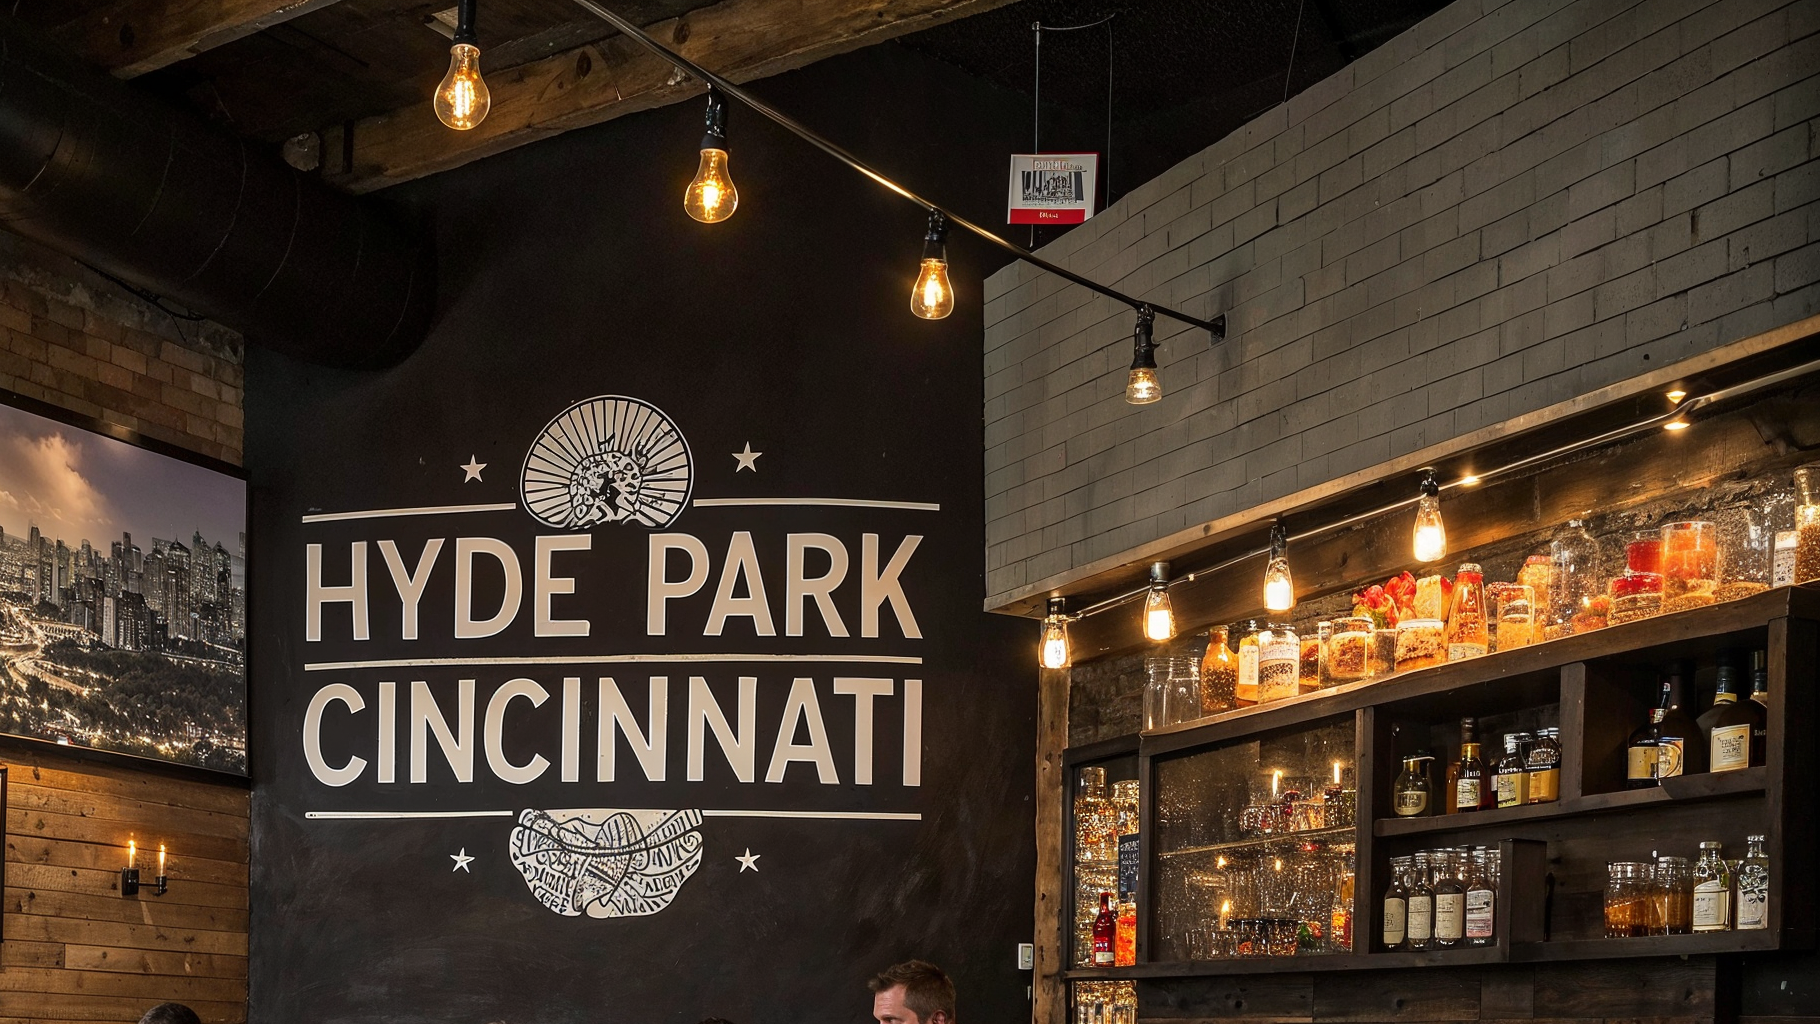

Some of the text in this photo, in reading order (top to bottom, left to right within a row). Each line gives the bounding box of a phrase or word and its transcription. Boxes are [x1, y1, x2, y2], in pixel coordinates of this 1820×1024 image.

[305, 530, 924, 641] HYDE PARK
[302, 676, 923, 788] CINCINNATI
